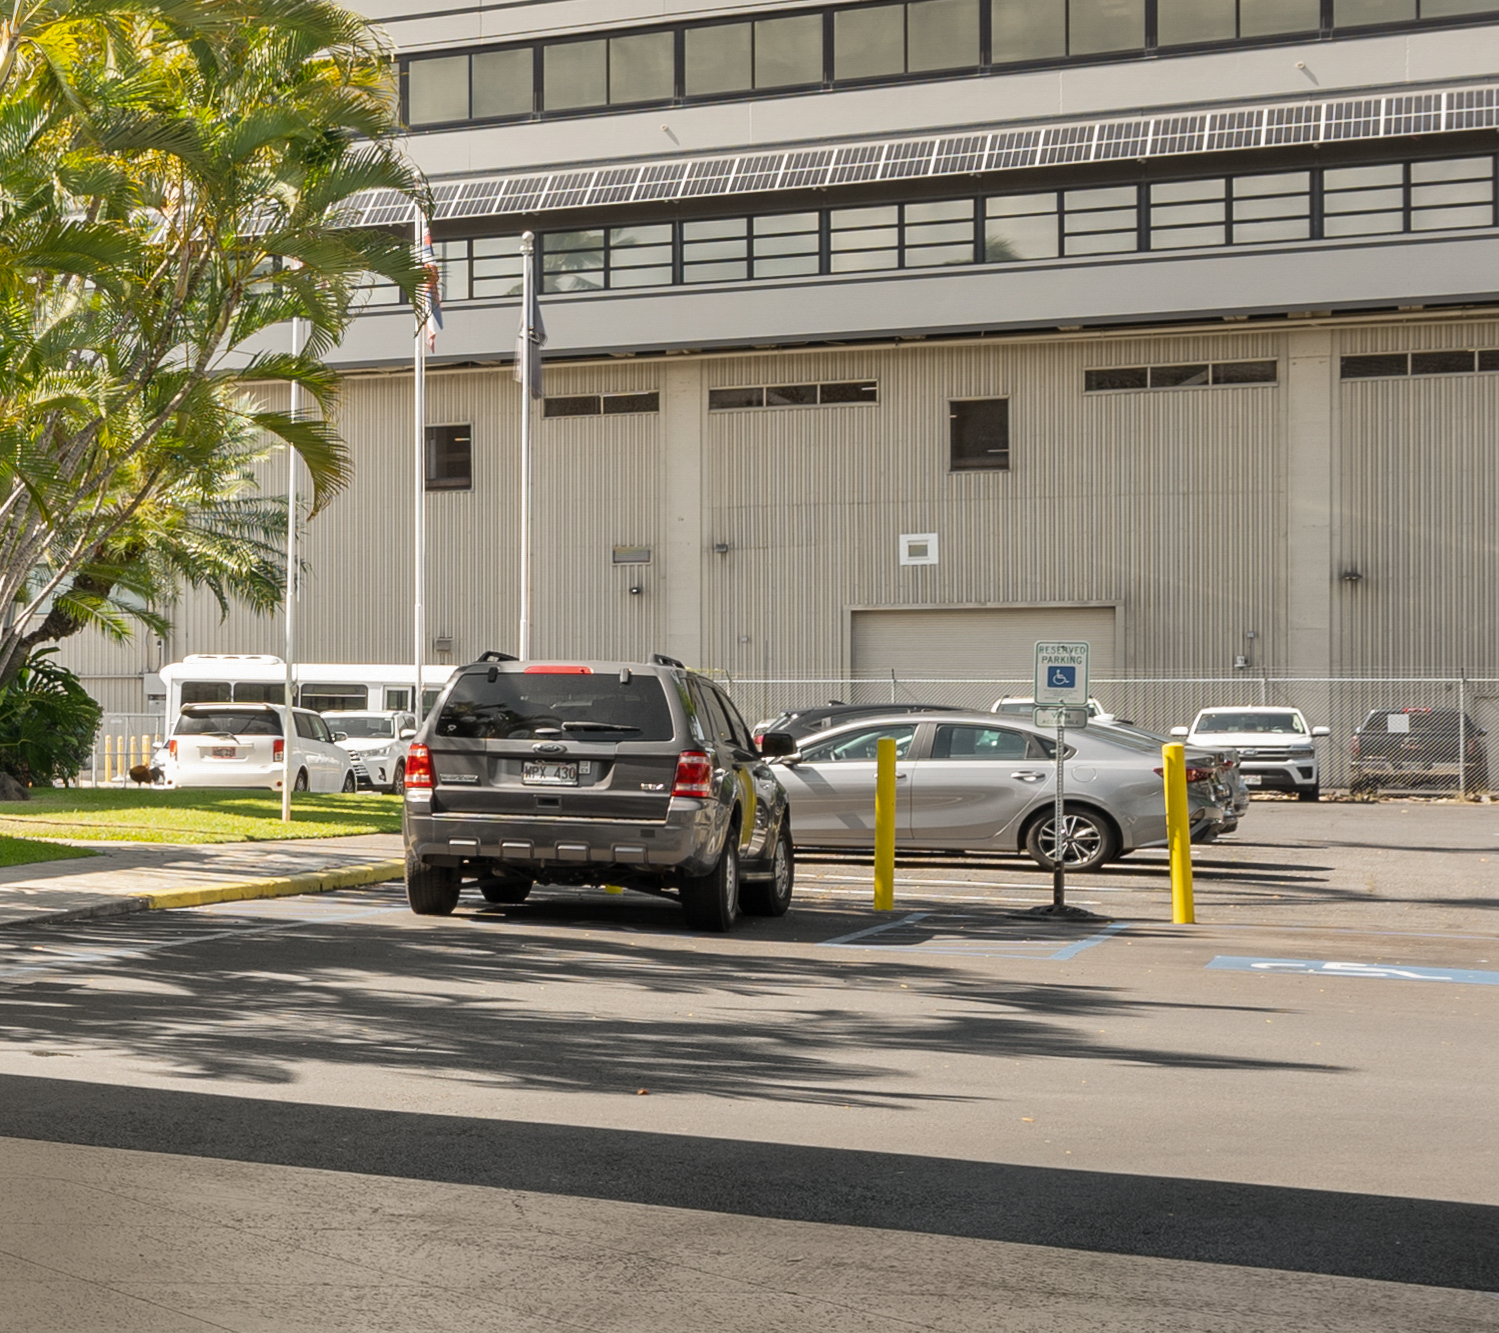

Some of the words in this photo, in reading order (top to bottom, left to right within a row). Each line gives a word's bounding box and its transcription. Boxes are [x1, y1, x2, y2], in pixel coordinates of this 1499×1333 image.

[1039, 646, 1086, 655] RESERVED
[1042, 656, 1083, 665] PARKING
[554, 767, 576, 779] 430
